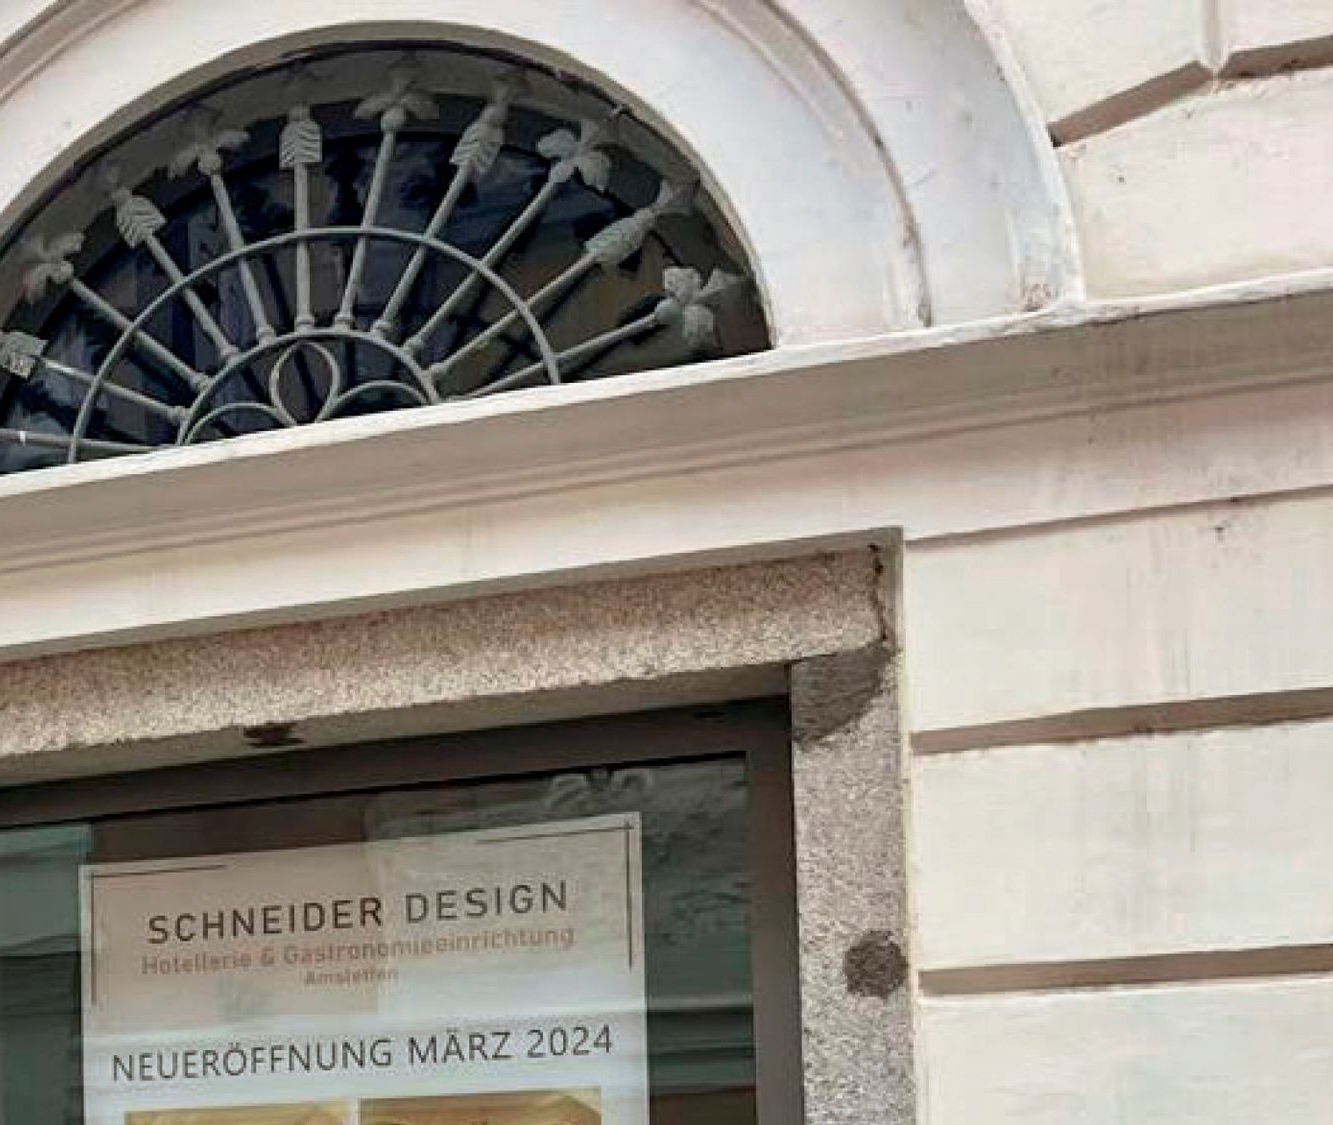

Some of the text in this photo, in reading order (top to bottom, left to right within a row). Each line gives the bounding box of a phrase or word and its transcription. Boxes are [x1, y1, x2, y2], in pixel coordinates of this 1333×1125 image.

[147, 880, 570, 945] SCHNEIDER DESIGN
[111, 1024, 614, 1083] NEUERÖFFNUNG MÄRZ 2024
